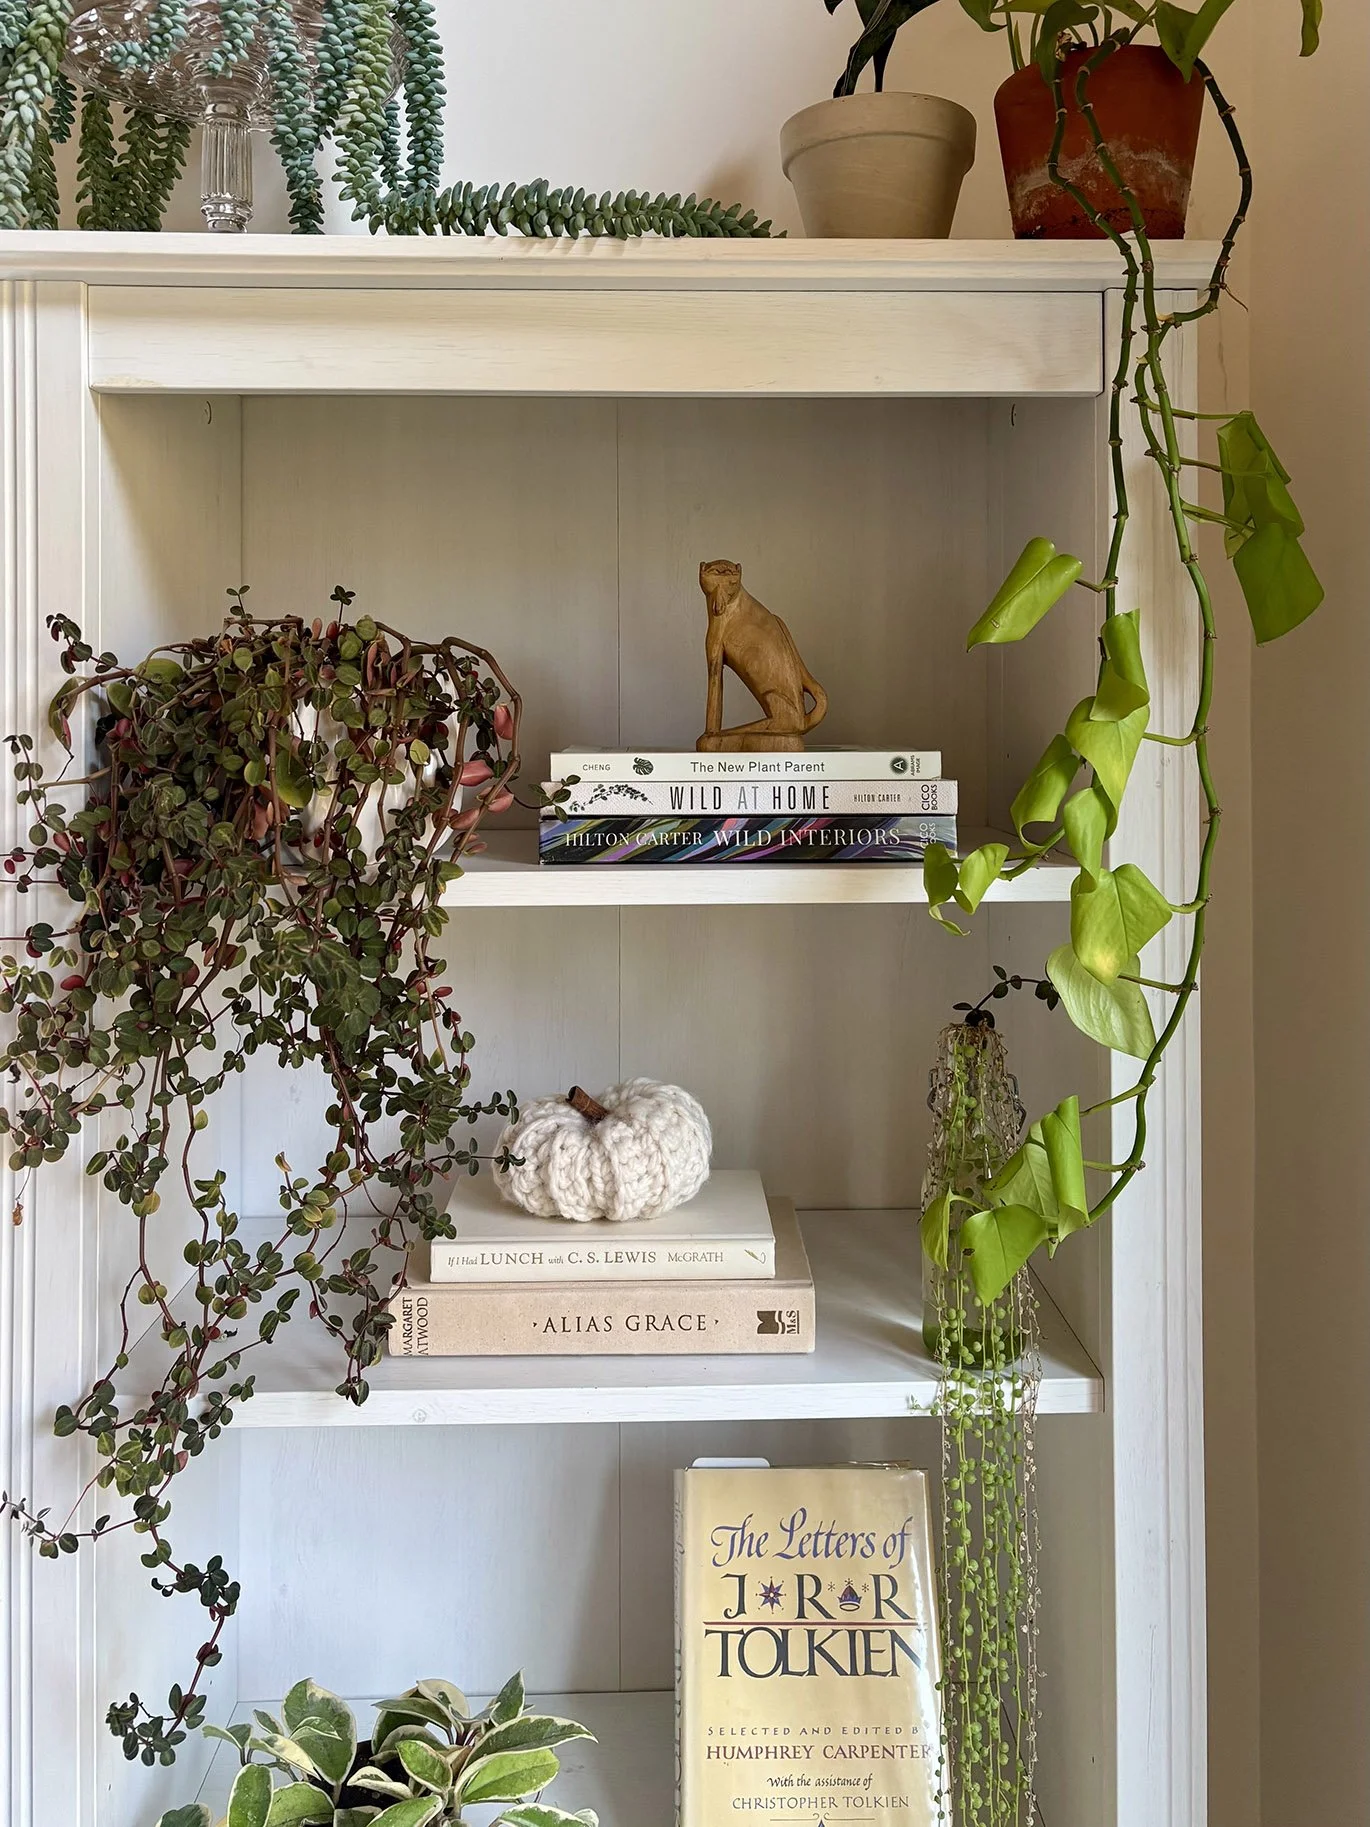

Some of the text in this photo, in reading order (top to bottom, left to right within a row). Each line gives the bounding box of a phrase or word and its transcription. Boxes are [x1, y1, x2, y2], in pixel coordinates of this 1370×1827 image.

[582, 763, 611, 771] CHENG
[690, 761, 825, 773] The New Plant Parent
[669, 785, 830, 810] WILD AT HOME
[853, 793, 901, 802] HILTON CARTER
[921, 784, 930, 810] CICO
[930, 784, 938, 810] BOOKS
[565, 828, 901, 847] HILTON CARTER WILD INTERIORS
[448, 1257, 456, 1268] If
[462, 1256, 478, 1265] Had
[480, 1253, 543, 1265] LUNCH
[548, 1256, 564, 1264] with
[567, 1252, 583, 1264] C.
[587, 1252, 600, 1264] S.
[604, 1251, 657, 1263] LEWIS
[667, 1252, 724, 1262] McGRATH
[402, 1297, 413, 1356] MARGARET
[417, 1297, 428, 1355] ATWOOD
[542, 1314, 707, 1333] ALIAS GRACE
[786, 1310, 797, 1334] M&S
[710, 1507, 913, 1569] The Letters of
[720, 1573, 917, 1620] J R R
[704, 1626, 930, 1678] TOLKIEN
[708, 1726, 790, 1736] SELECTED
[799, 1725, 831, 1735] AND
[842, 1726, 902, 1735] EDITED
[706, 1744, 814, 1760] HUMPHREY
[767, 1773, 873, 1791] With the assistance of
[732, 1795, 910, 1809] CHRISTOPHER TOLKIEN
